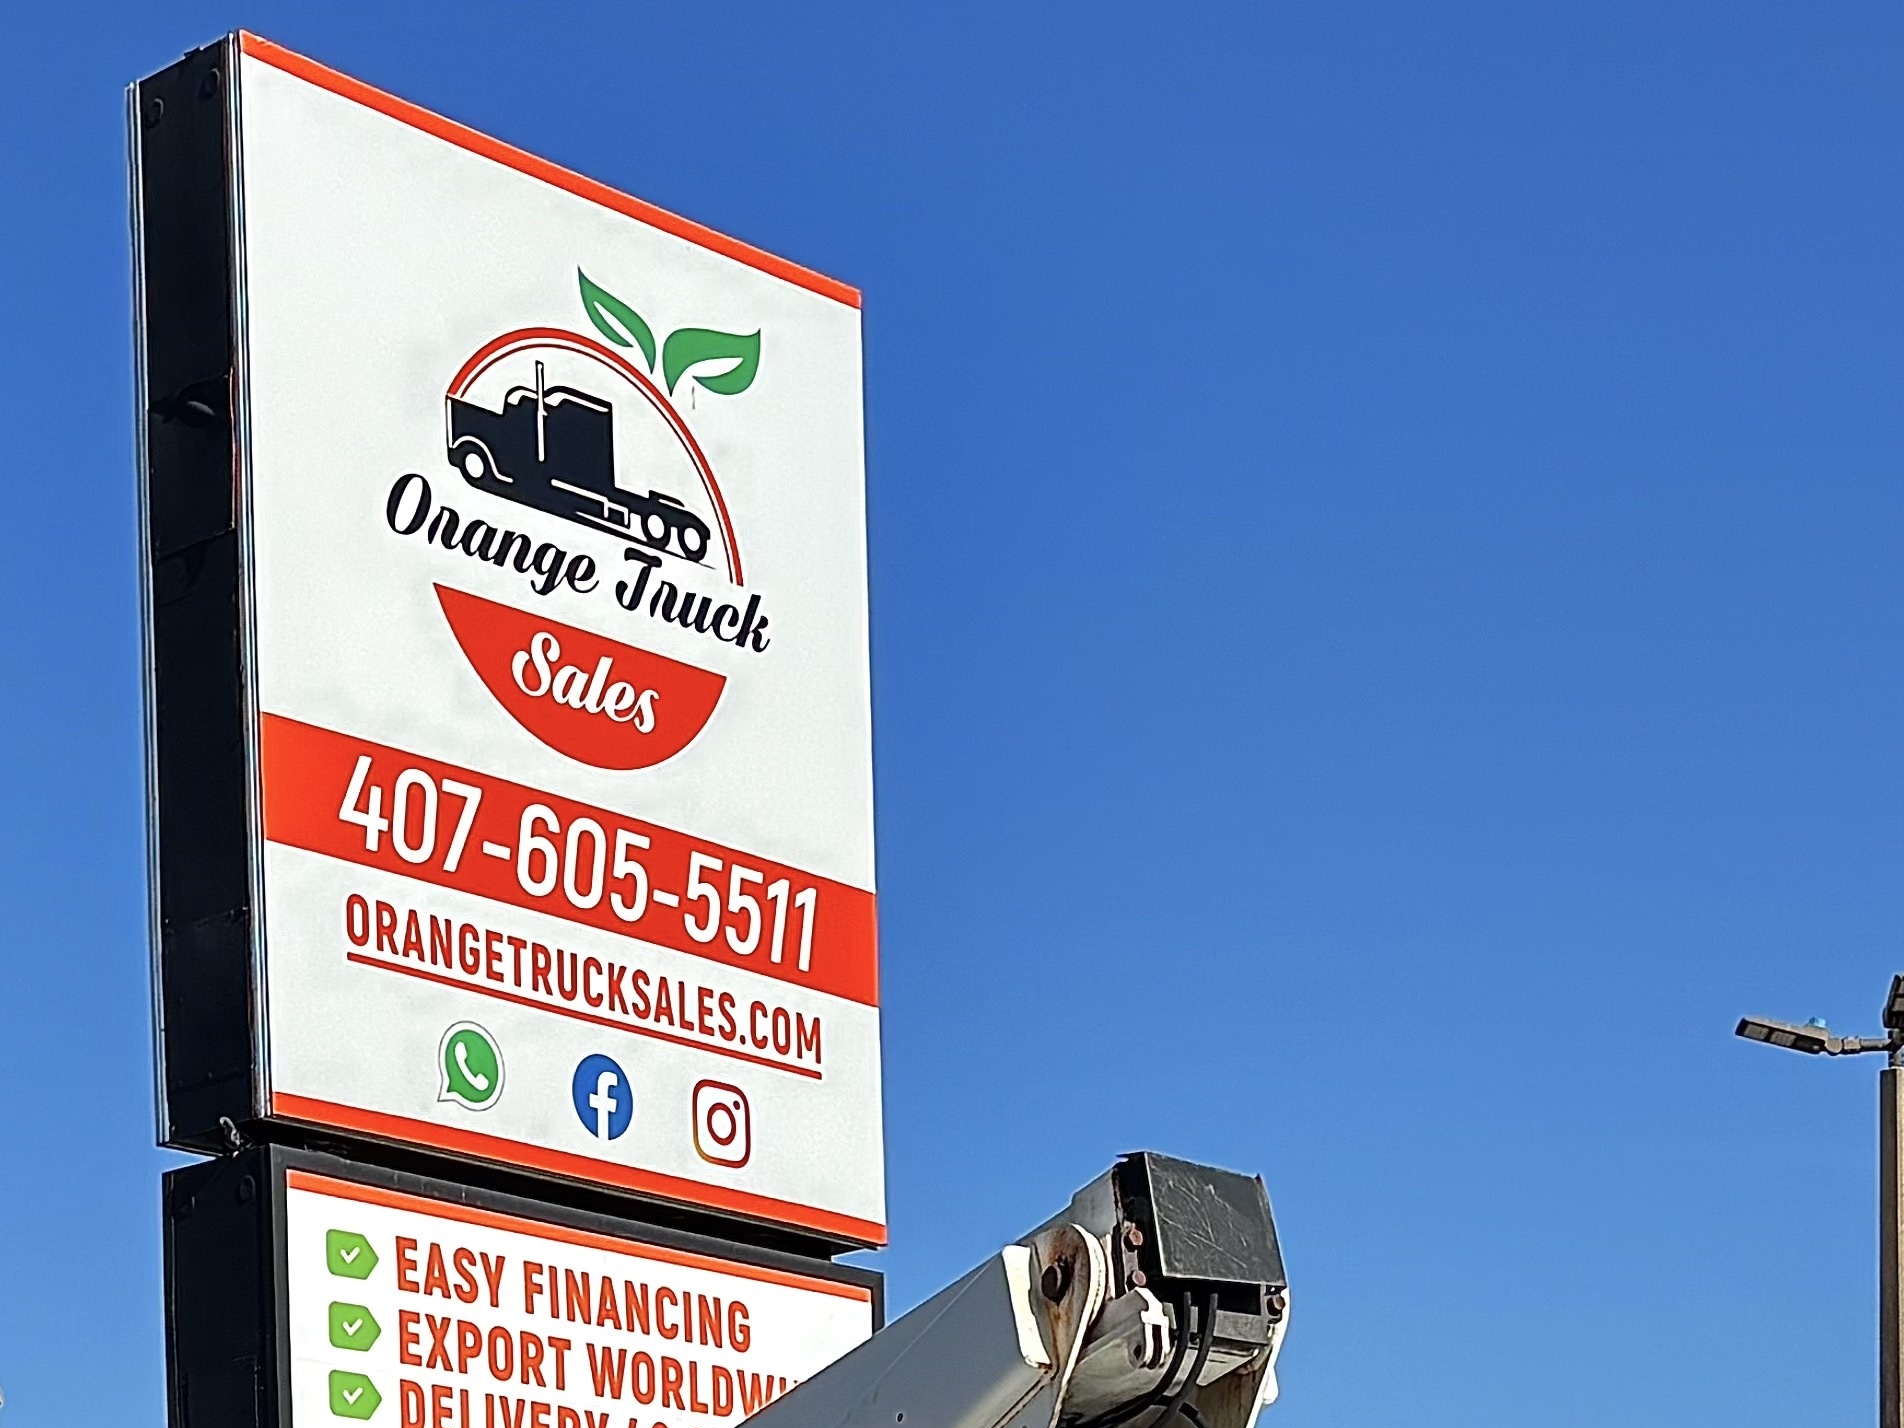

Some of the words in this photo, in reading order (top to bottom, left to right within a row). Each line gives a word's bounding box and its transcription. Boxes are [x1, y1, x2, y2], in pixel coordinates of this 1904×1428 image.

[386, 473, 599, 597] Orange
[615, 547, 771, 654] Truck
[511, 630, 661, 734] Sales
[338, 754, 818, 974] 407-605-5511
[345, 892, 823, 1066] ORANGETRUCKSALES.COM
[395, 1236, 505, 1309] EASY
[523, 1260, 751, 1353] FINANCING
[398, 1308, 572, 1391] EXPORT
[586, 1342, 798, 1418] WORLDW
